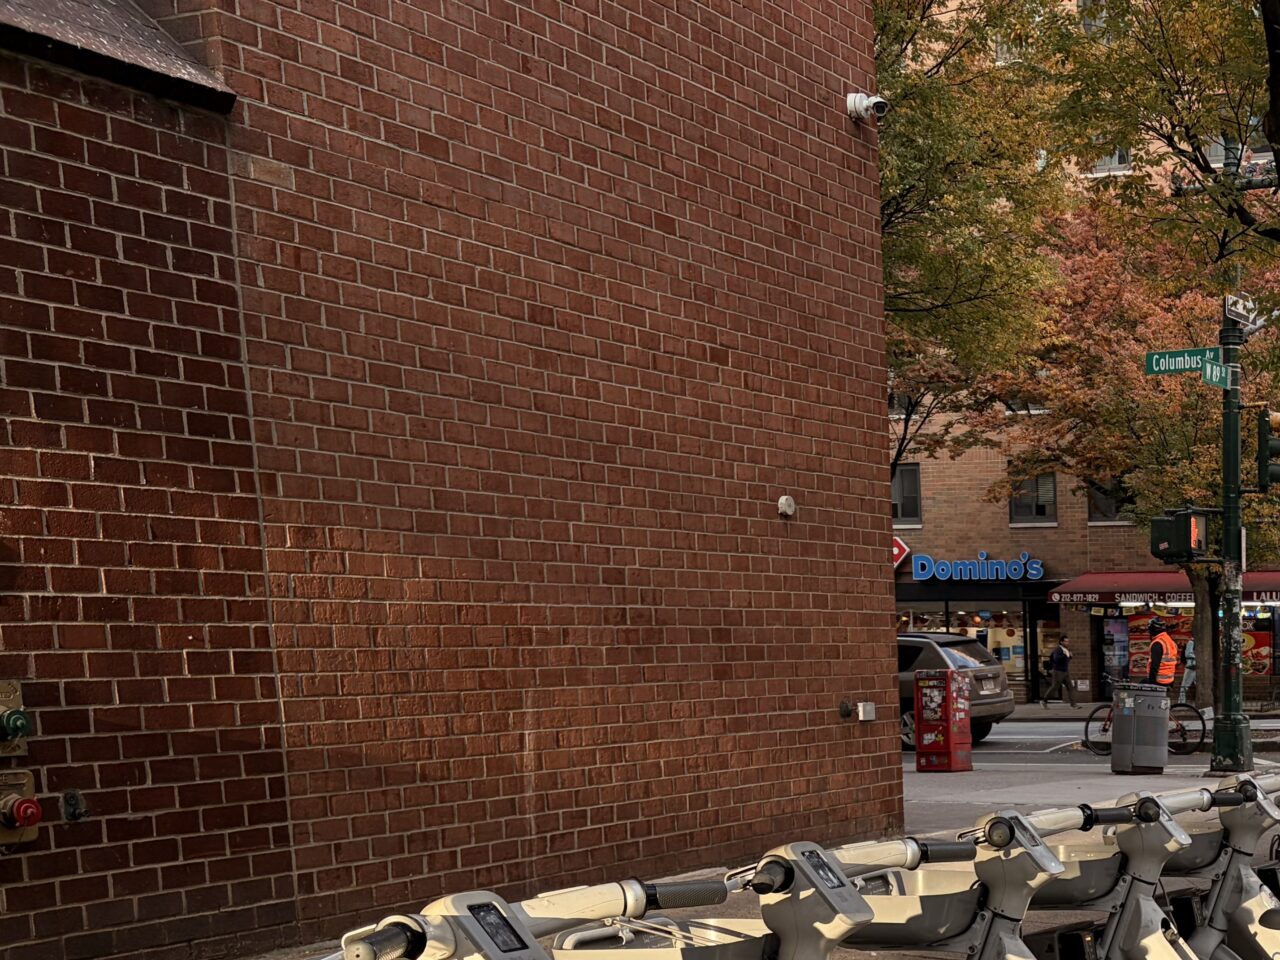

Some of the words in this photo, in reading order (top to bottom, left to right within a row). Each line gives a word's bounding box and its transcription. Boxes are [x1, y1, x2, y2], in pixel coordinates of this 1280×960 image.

[1153, 353, 1202, 371] Columbus
[1206, 350, 1214, 359] Av
[1206, 363, 1212, 380] W
[1213, 366, 1220, 382] 89
[912, 551, 1044, 580] Domino's
[1114, 592, 1158, 602] SANDWICH
[1253, 591, 1280, 601] LALU
